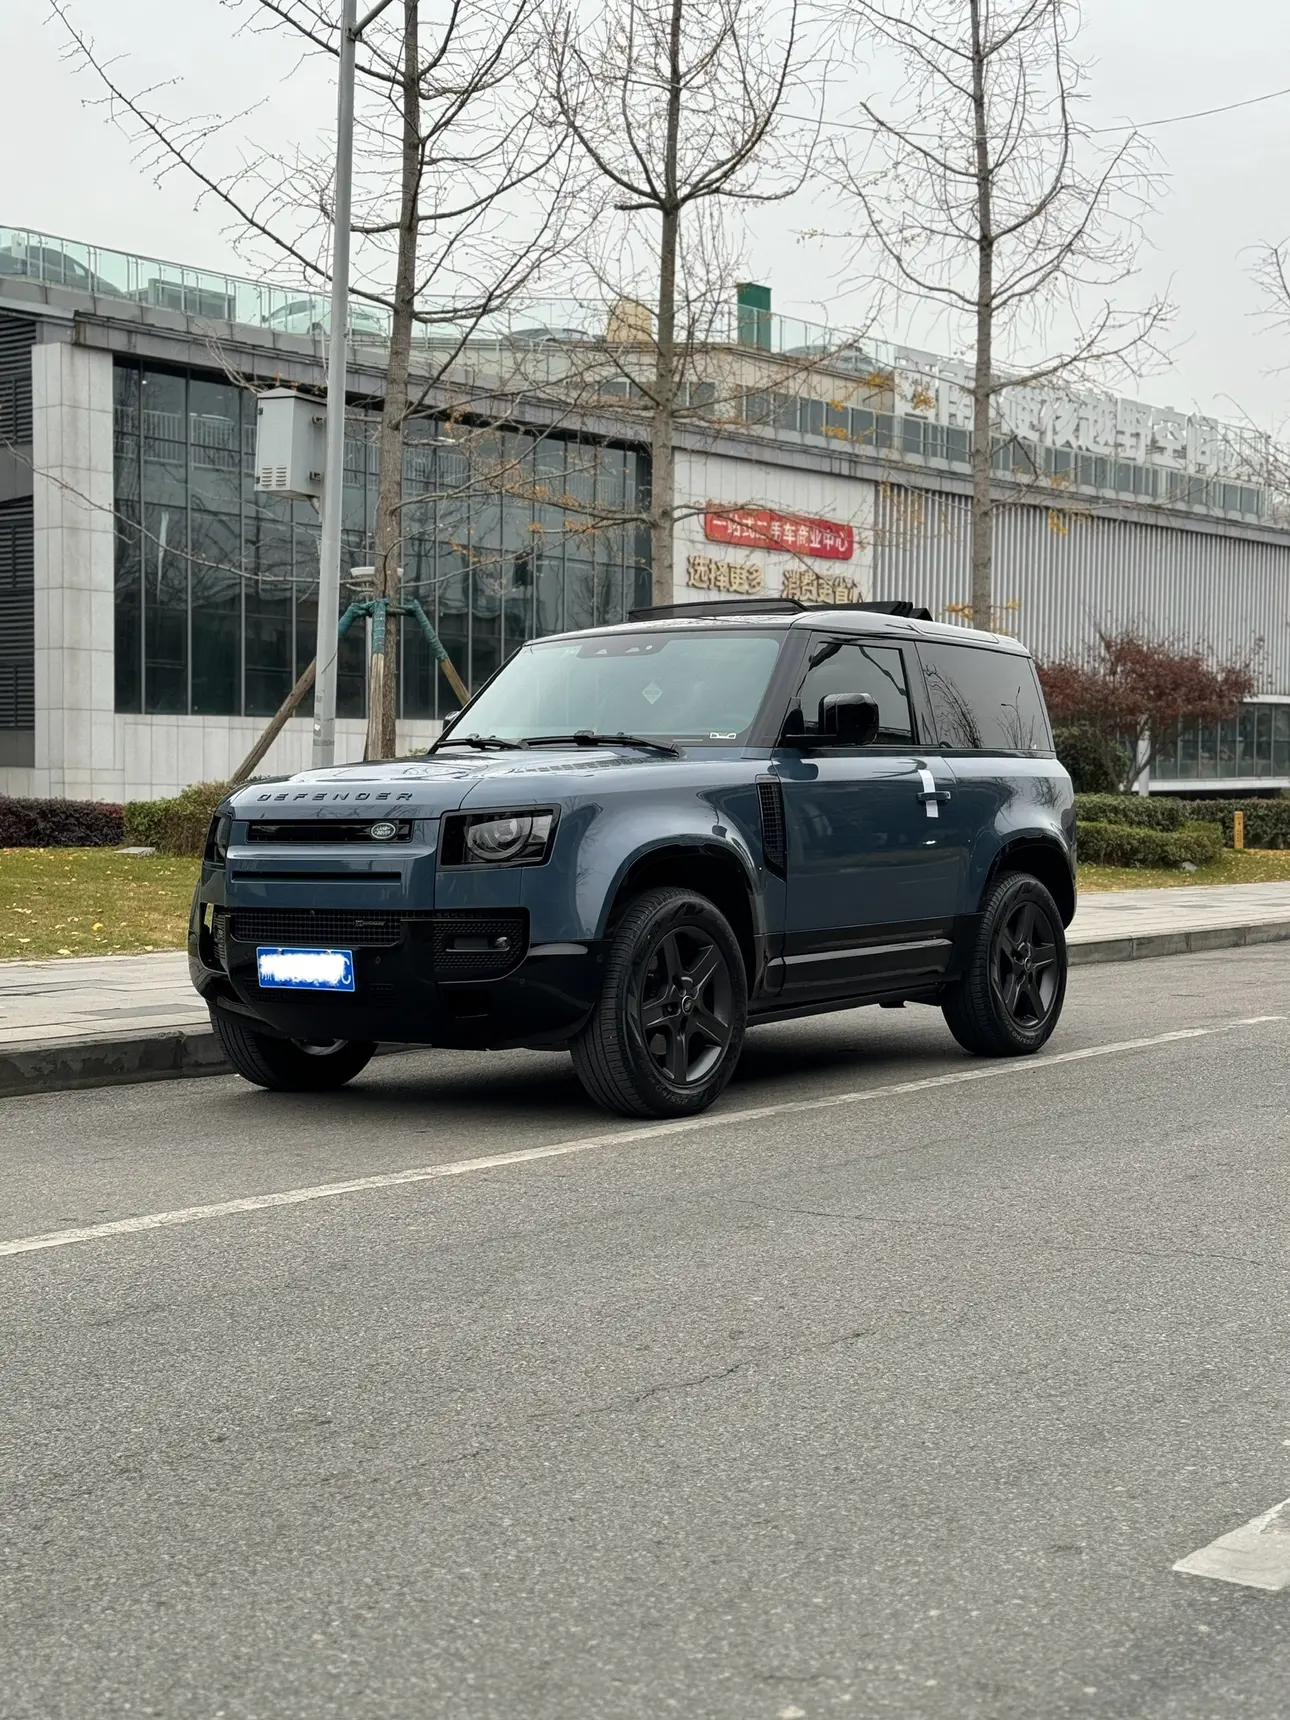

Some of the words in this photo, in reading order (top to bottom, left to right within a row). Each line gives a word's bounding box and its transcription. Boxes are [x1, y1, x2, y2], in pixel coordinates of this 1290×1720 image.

[712, 513, 848, 552] 一站式二手车商业中心
[687, 555, 765, 595] 选择更多
[780, 568, 864, 604] 消费更省心
[256, 792, 413, 802] DEFENDER
